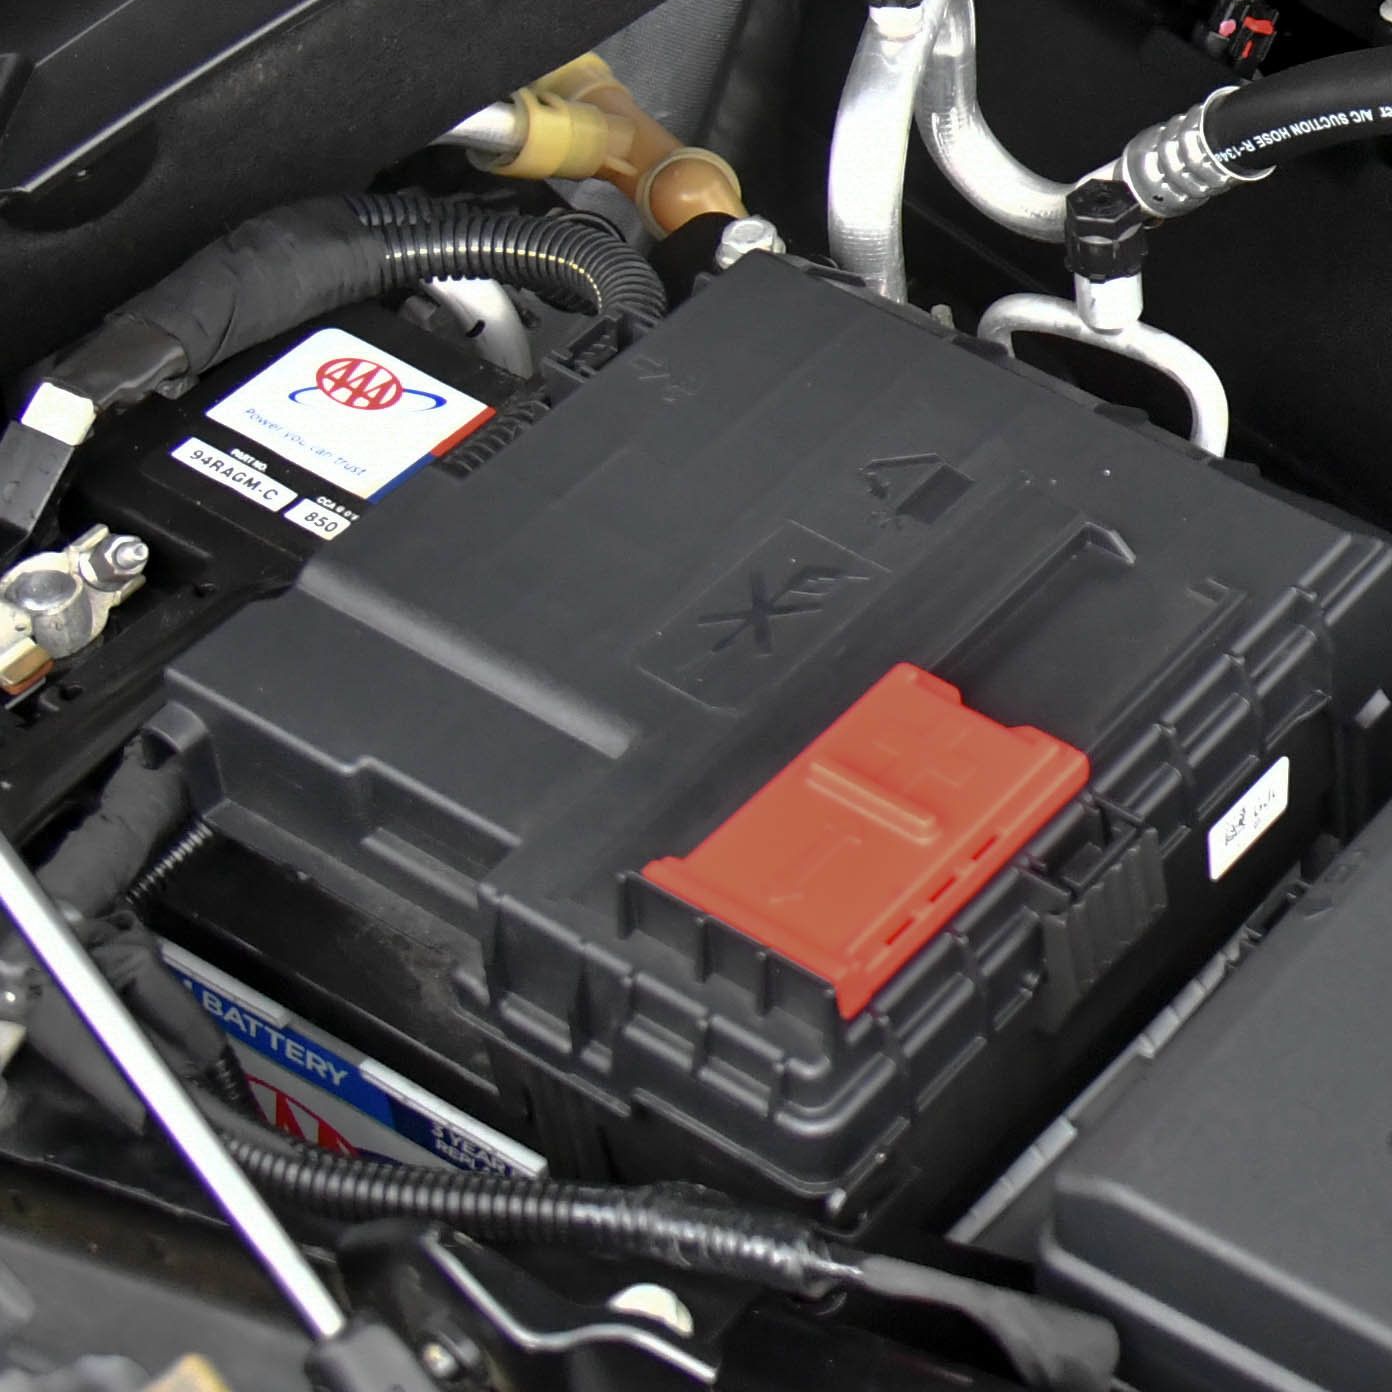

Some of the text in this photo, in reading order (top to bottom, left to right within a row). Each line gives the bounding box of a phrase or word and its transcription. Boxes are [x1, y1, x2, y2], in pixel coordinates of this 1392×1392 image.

[1289, 112, 1349, 136] SUCTION
[1349, 109, 1374, 123] A/C
[1253, 126, 1292, 148] HOSE
[318, 358, 402, 409] AAA
[244, 408, 284, 432] Power
[333, 456, 367, 477] trust
[190, 449, 279, 501] 94RAGM-C
[304, 511, 338, 533] 850
[202, 990, 349, 1087] BATTERY
